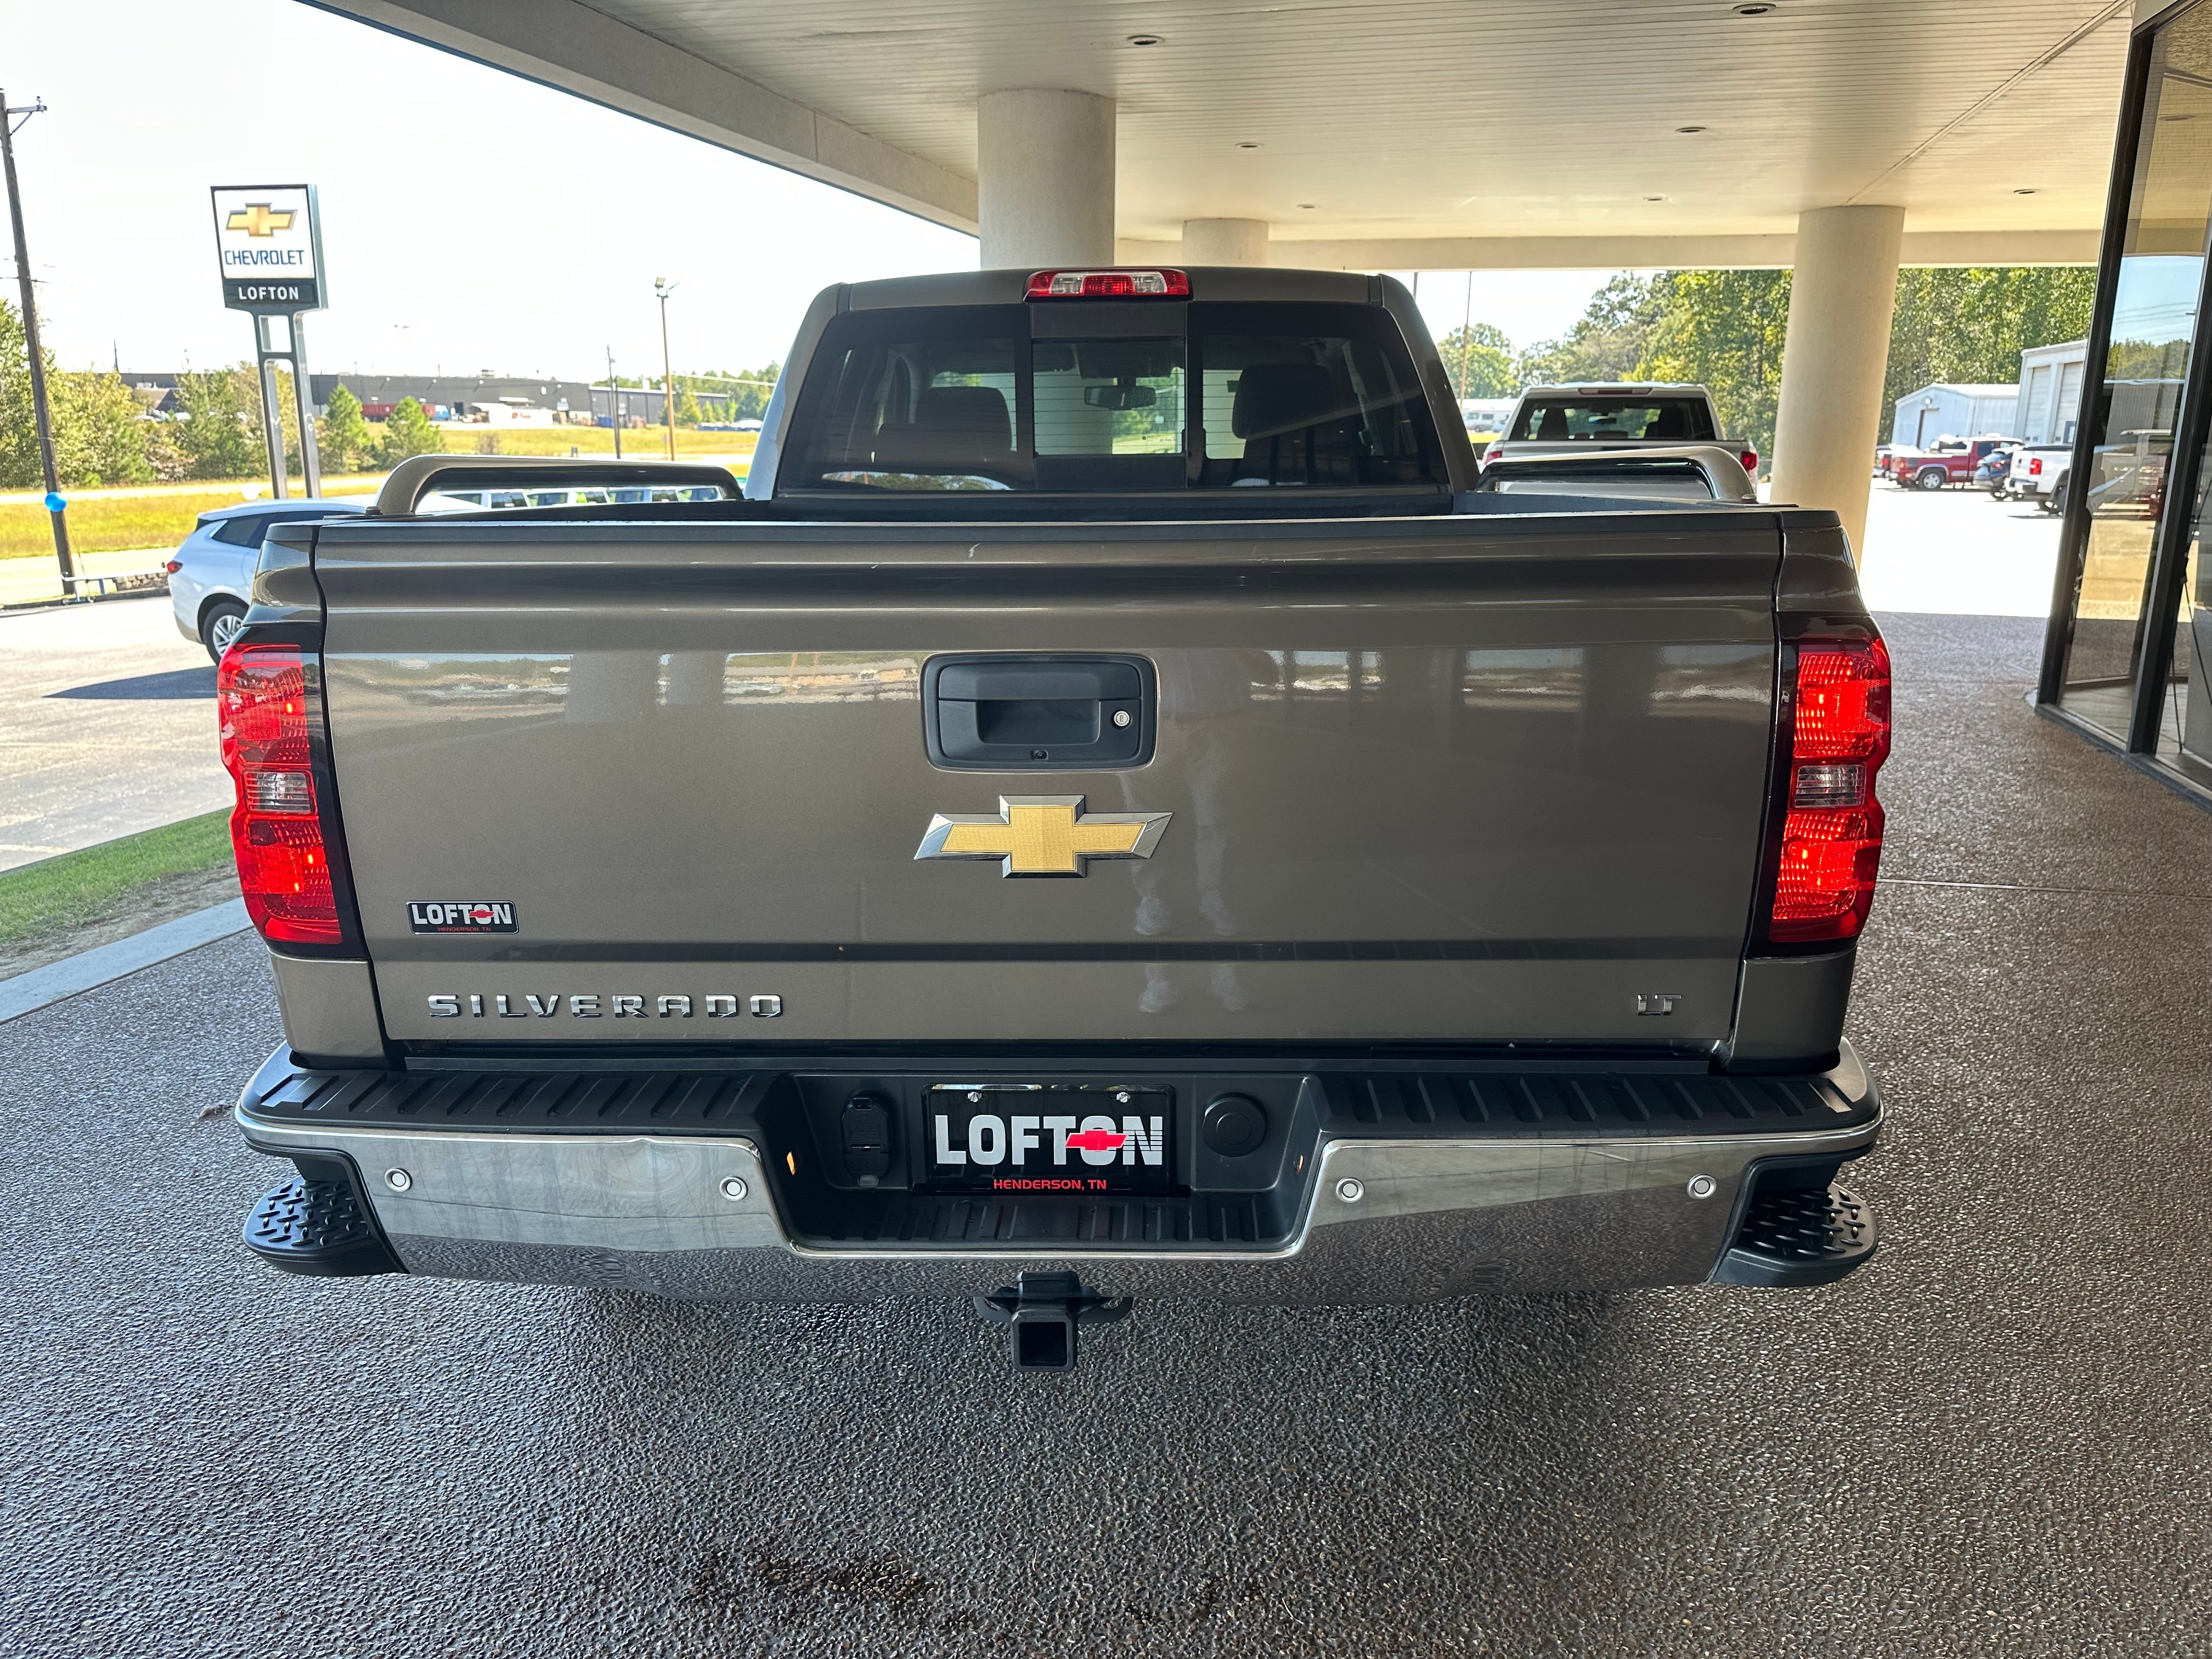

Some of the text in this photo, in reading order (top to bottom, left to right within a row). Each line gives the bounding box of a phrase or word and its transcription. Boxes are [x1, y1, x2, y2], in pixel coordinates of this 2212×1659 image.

[224, 250, 304, 265] CHEVROLET
[238, 286, 299, 300] LOFTON
[411, 904, 512, 924] LOFTON
[427, 994, 782, 1018] SILVERADO
[1637, 994, 1681, 1015] LT
[935, 1114, 1163, 1165] LOFTON
[994, 1179, 1107, 1190] HENDERSON, TN
